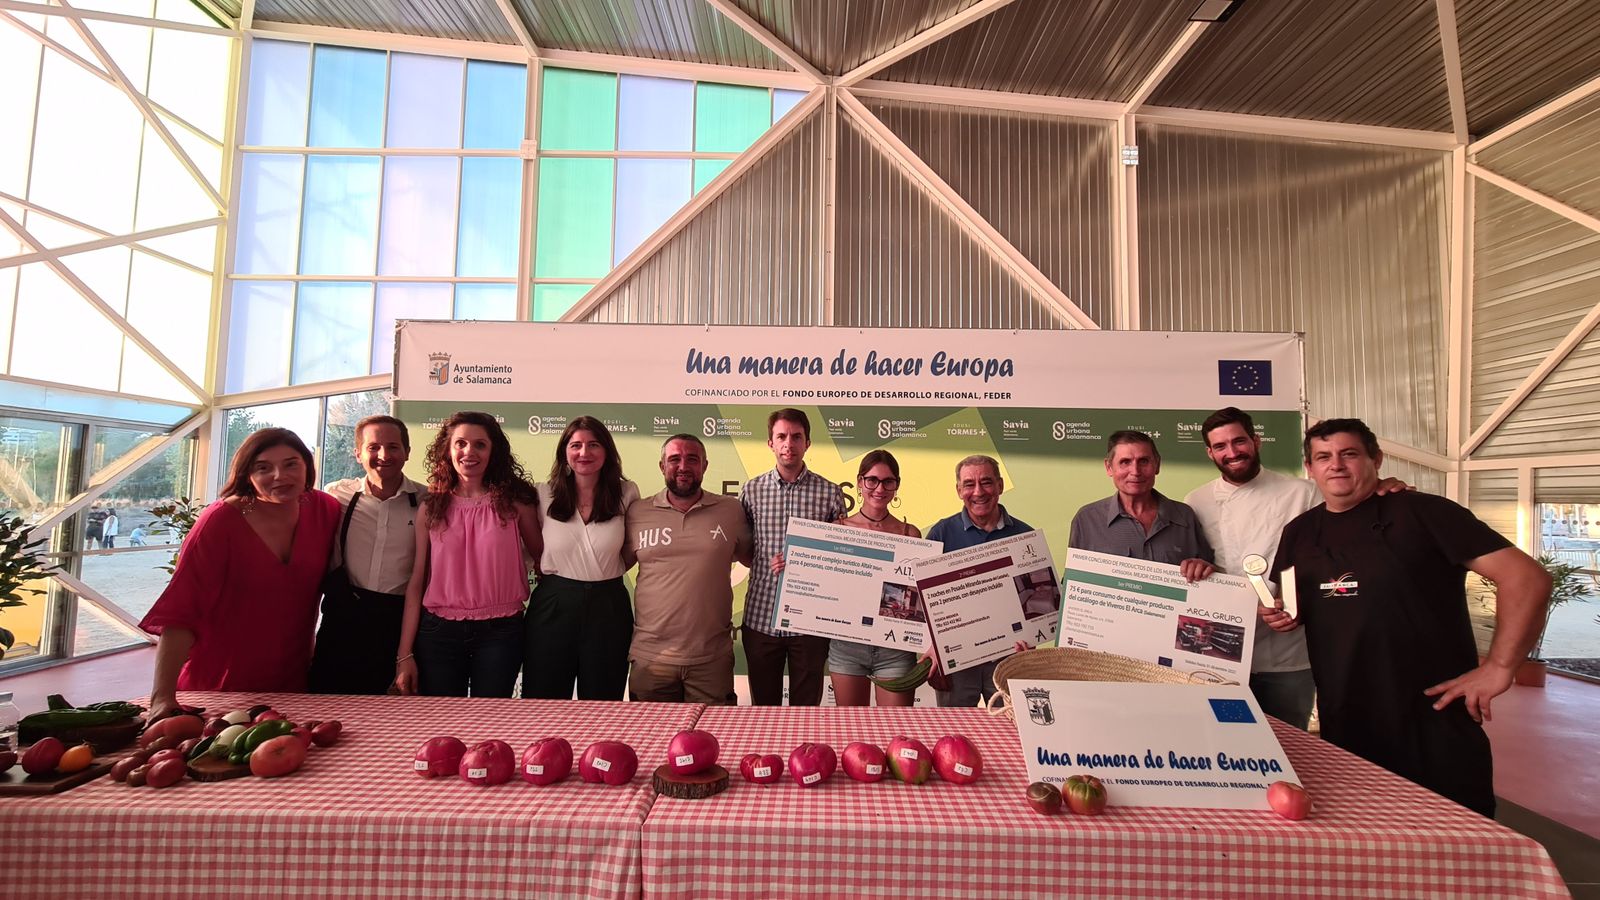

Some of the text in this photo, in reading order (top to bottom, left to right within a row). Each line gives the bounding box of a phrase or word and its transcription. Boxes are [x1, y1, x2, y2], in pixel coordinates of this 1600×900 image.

[454, 364, 512, 373] Ayuntamiento
[686, 348, 1013, 383] Una manera de hacer Europa
[454, 375, 512, 384] de Salamanca
[685, 389, 749, 397] COFINANCIADO
[934, 392, 981, 400] REGIONAL,
[654, 416, 679, 425] Savia
[829, 418, 854, 427] Savia
[1004, 420, 1029, 429] Savia
[1178, 422, 1203, 431] Savia
[639, 527, 672, 549] HUS
[873, 541, 896, 549] PRODUCTOS
[822, 556, 842, 565] complejo
[834, 565, 854, 575] desayuno
[1088, 557, 1112, 566] CONCURSO
[1120, 562, 1146, 571] PRODUCTOS
[1217, 579, 1246, 588] SALAMANCA
[930, 589, 945, 598] noches
[950, 583, 965, 592] Posada
[964, 579, 981, 588] Miranda
[968, 586, 988, 597] desayuno
[987, 582, 1003, 590] incluido
[1077, 596, 1098, 605] catálogo
[1107, 601, 1125, 610] Viveros
[1093, 591, 1116, 600] consumo
[1124, 596, 1148, 606] cualquier
[1149, 601, 1174, 611] producto
[1187, 608, 1242, 623] ARCA GRUPO
[1038, 747, 1282, 776] Una manera de hacer Europa
